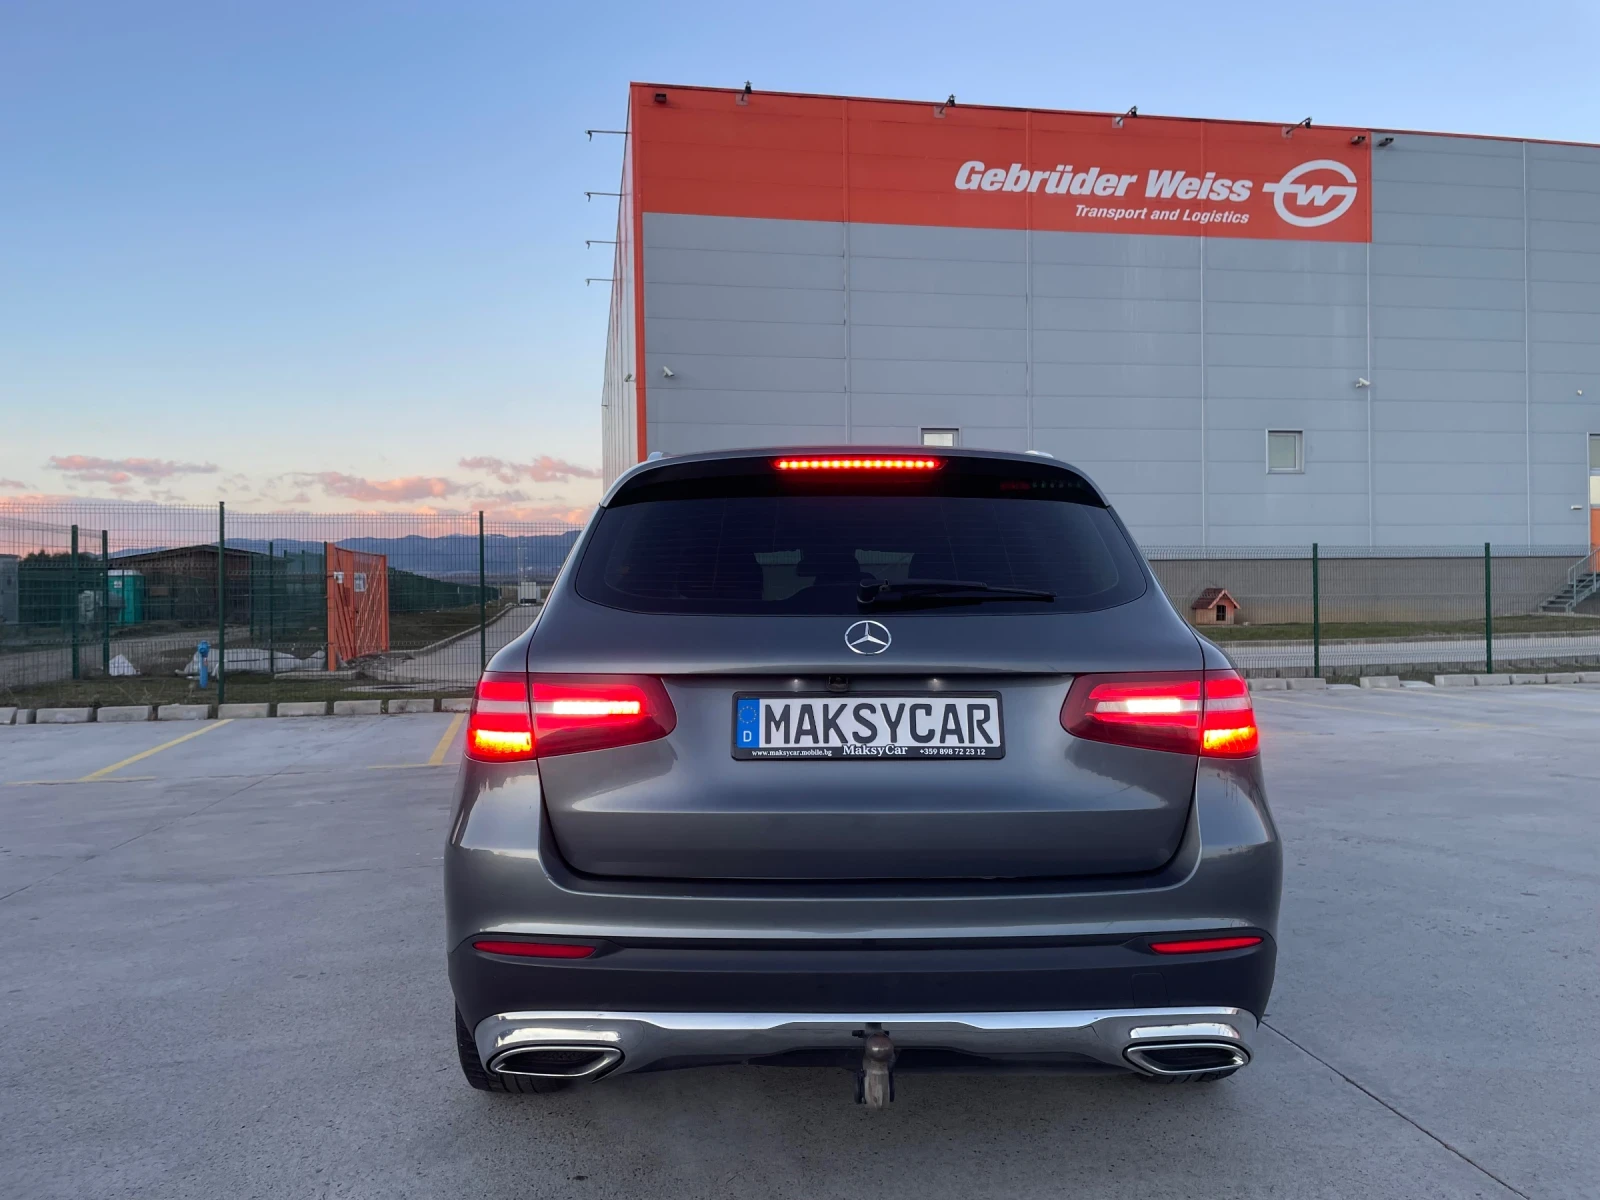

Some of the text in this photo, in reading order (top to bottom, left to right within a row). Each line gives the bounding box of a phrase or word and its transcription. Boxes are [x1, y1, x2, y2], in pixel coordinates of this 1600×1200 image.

[954, 160, 1253, 203] Gebrüder Weiss
[1075, 204, 1250, 225] Transport and Logistics
[764, 702, 994, 745] MAKSYCAR
[743, 730, 752, 742] D
[751, 748, 832, 757] www.maksycar.mobile.bg
[842, 744, 908, 757] MaksyCar
[919, 748, 986, 756] +359 898 72 23 12
